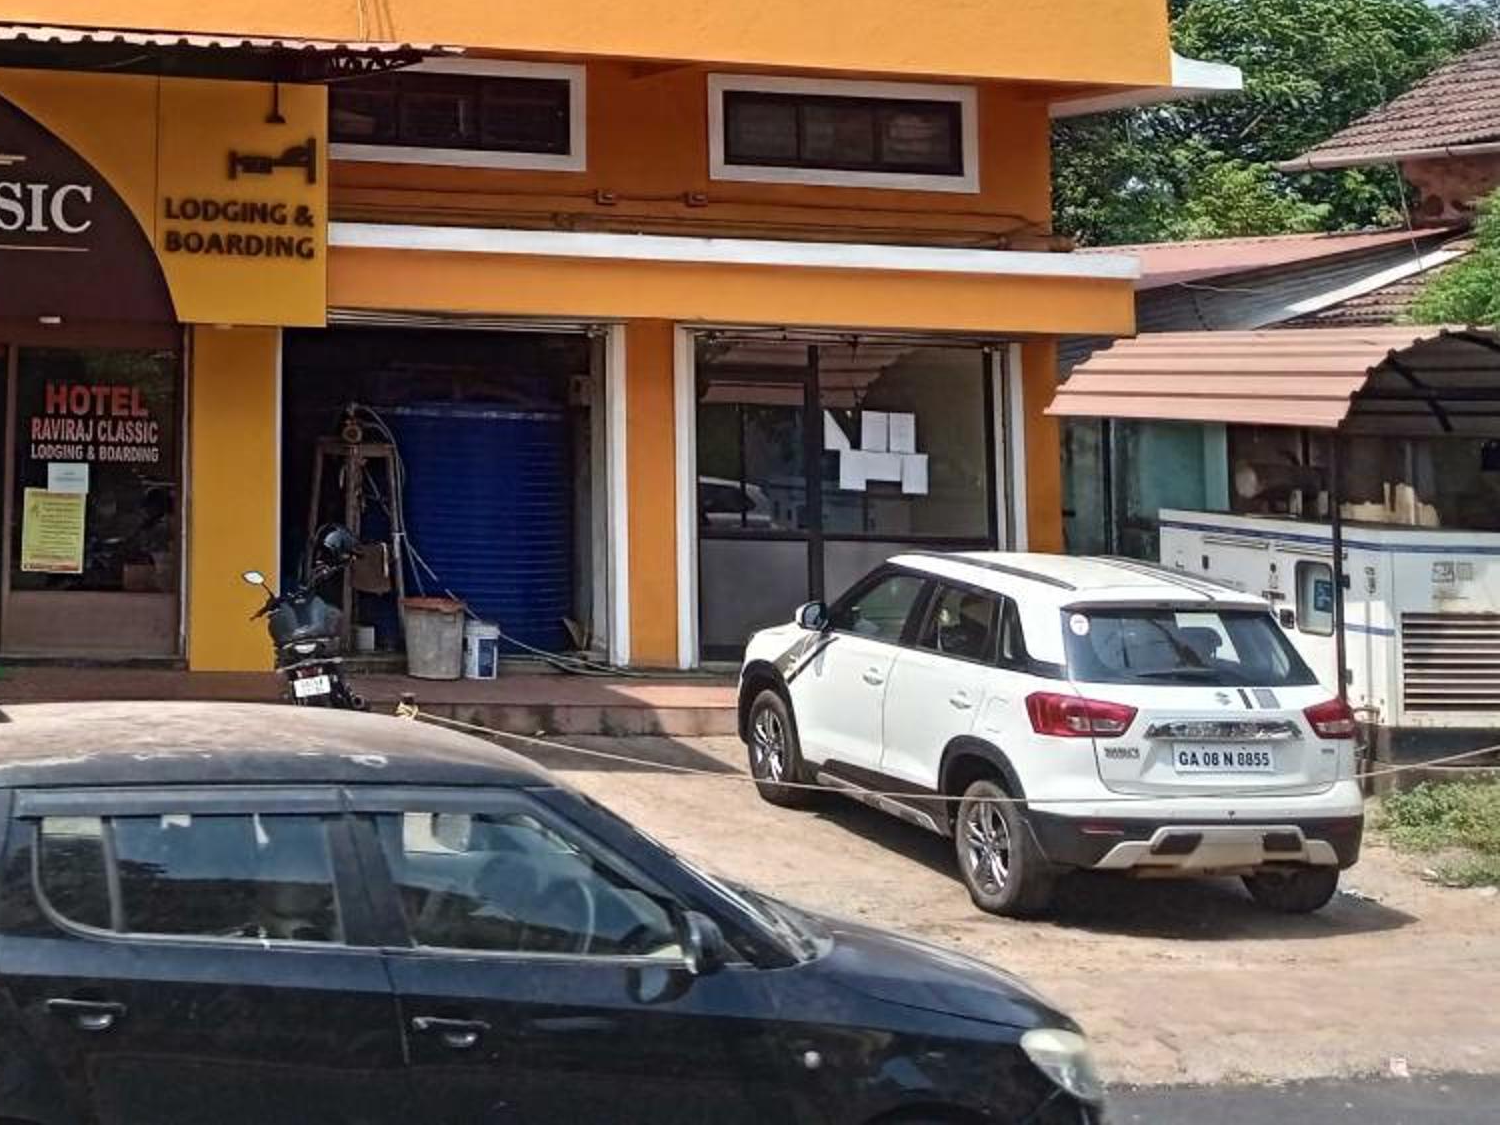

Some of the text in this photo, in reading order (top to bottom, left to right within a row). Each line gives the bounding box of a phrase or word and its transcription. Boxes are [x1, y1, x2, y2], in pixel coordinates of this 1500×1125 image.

[164, 197, 315, 228] LODGING &
[164, 230, 315, 260] BOARDING
[44, 382, 149, 417] HOTEL
[31, 417, 159, 445] RAVIRAJ CLASSIC
[31, 443, 160, 463] LODGING & BOARDING
[1179, 751, 1200, 767] GA
[1203, 751, 1219, 767] 08
[1223, 751, 1233, 767] N
